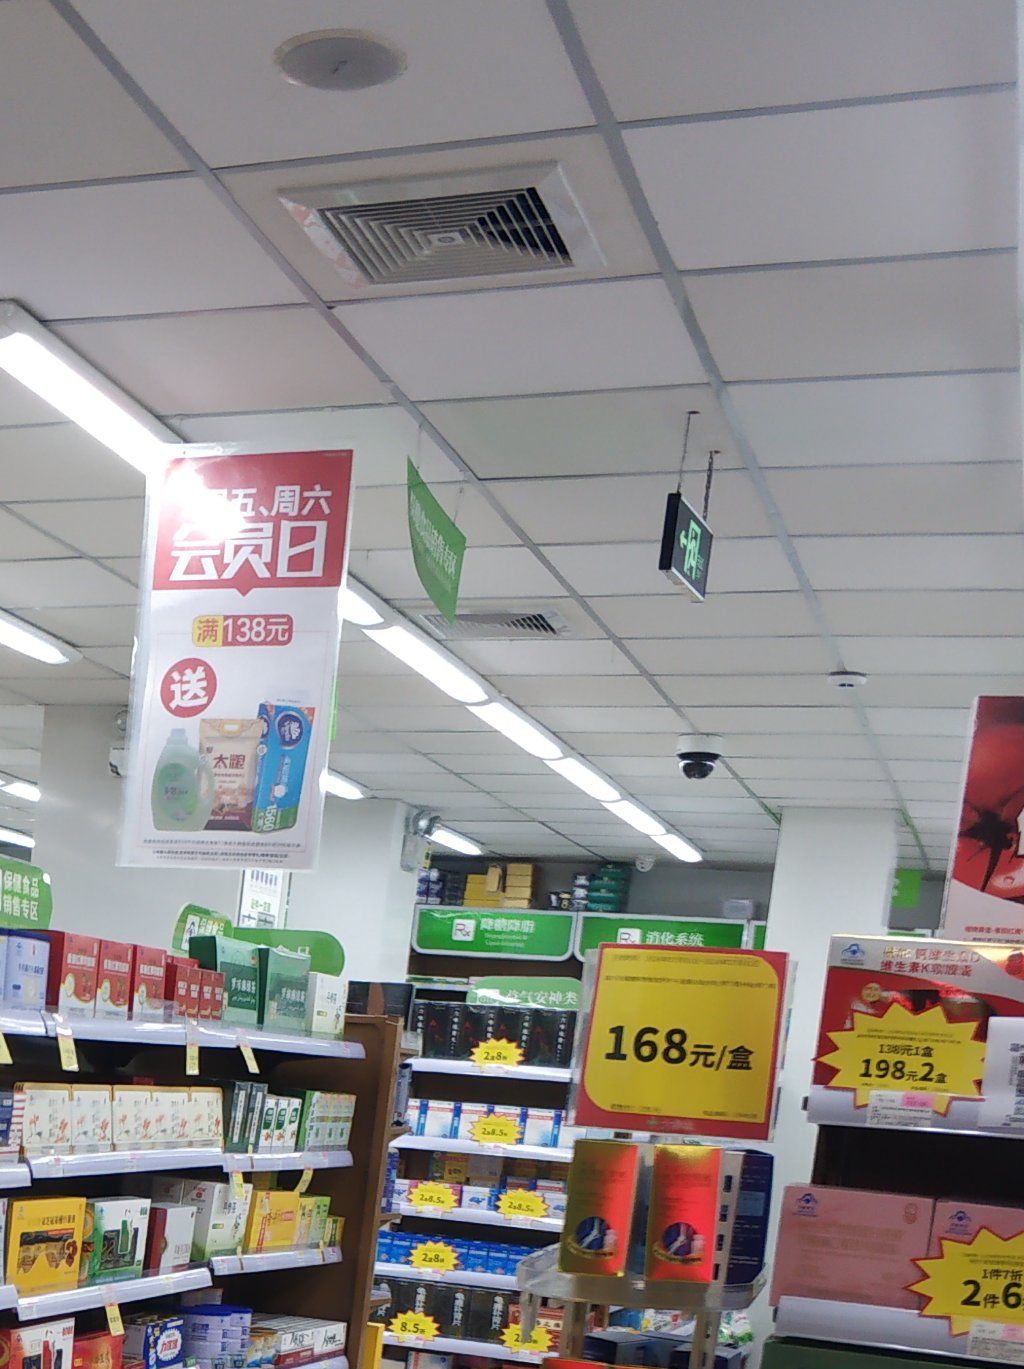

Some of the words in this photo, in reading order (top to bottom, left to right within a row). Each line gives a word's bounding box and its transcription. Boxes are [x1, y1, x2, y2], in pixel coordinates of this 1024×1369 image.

[214, 485, 332, 516] 五、周六
[169, 518, 326, 582] 会员日
[196, 616, 290, 644] 满138元
[171, 666, 208, 709] 送
[645, 931, 704, 947] 消化系统
[604, 1024, 754, 1071] 168元/盒
[859, 1058, 948, 1084] 198元2盒
[960, 1279, 1024, 1311] 2件6
